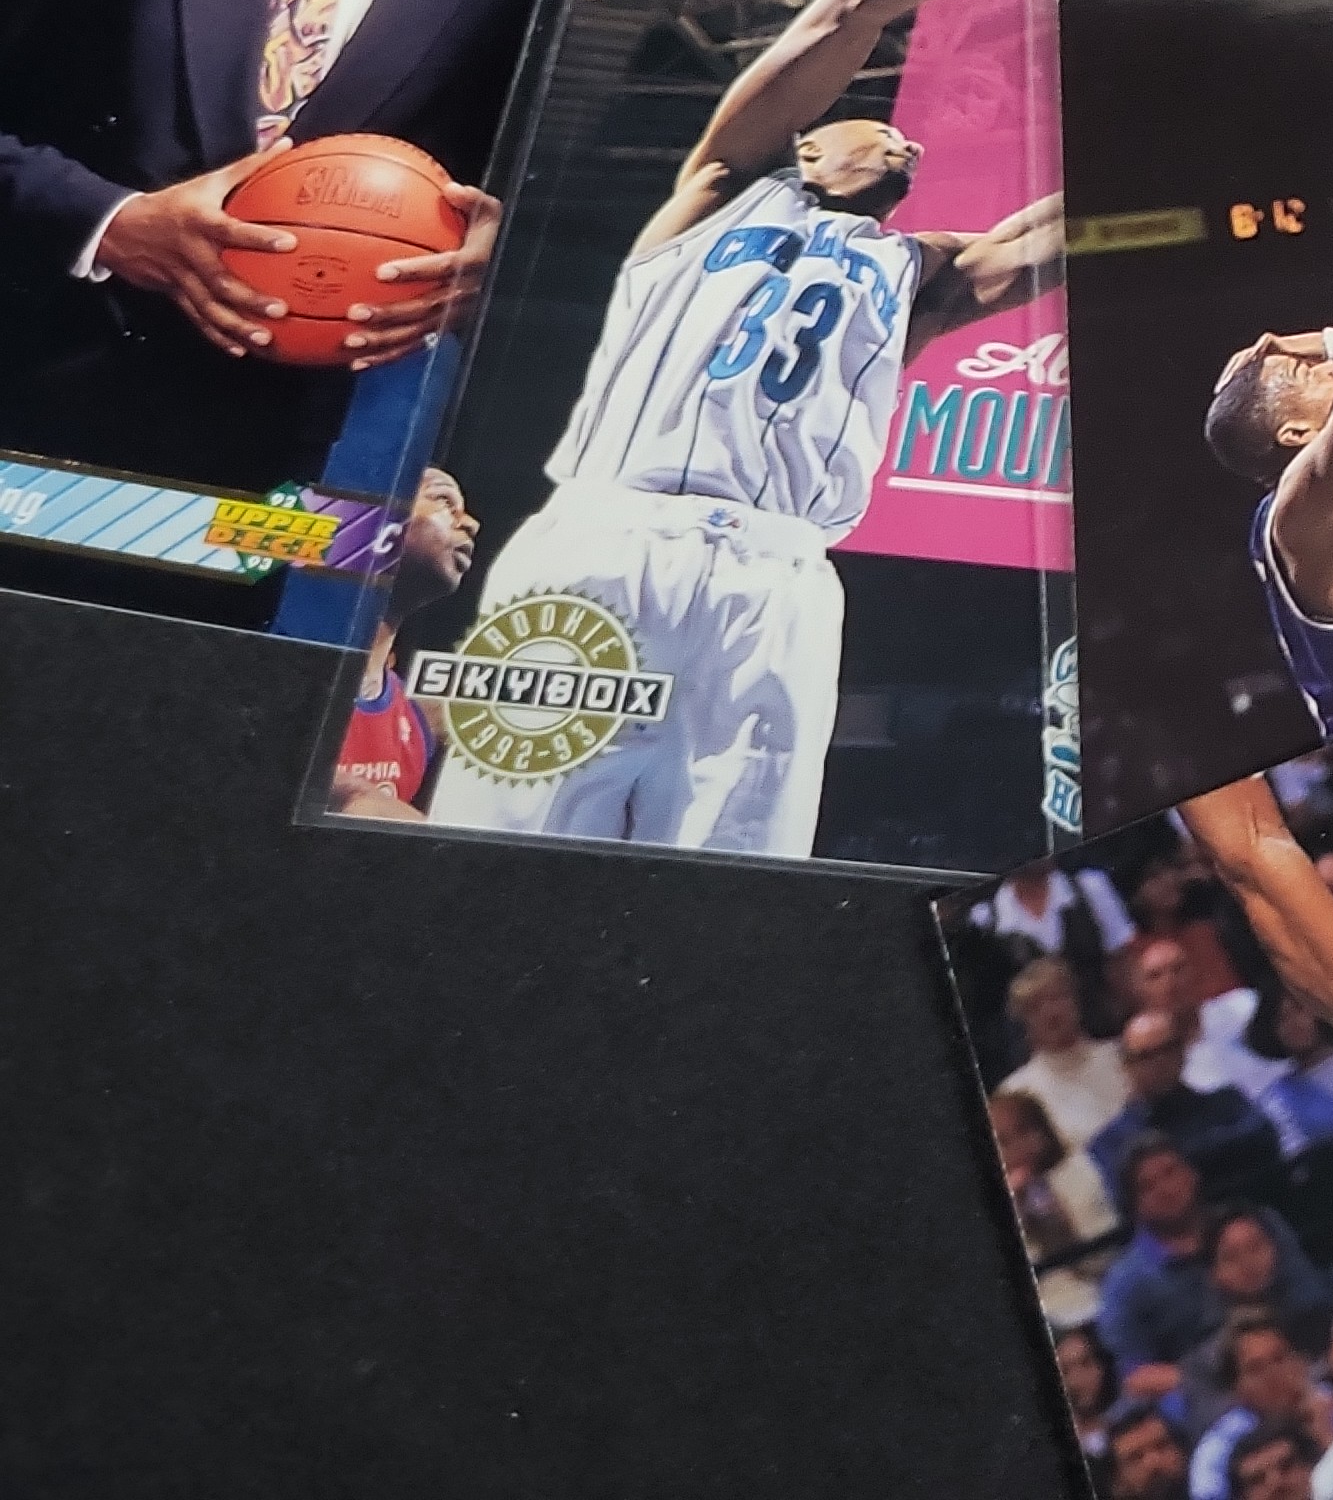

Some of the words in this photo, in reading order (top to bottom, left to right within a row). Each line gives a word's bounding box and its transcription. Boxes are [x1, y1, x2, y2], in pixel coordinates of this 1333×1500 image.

[708, 275, 844, 403] 33
[214, 501, 340, 539] UPPER
[269, 492, 299, 510] 92
[204, 522, 334, 561] DECK
[246, 555, 274, 572] 93
[482, 603, 622, 661] ROOKIE
[422, 661, 660, 715] SKYBOX
[459, 707, 598, 771] 1992-93
